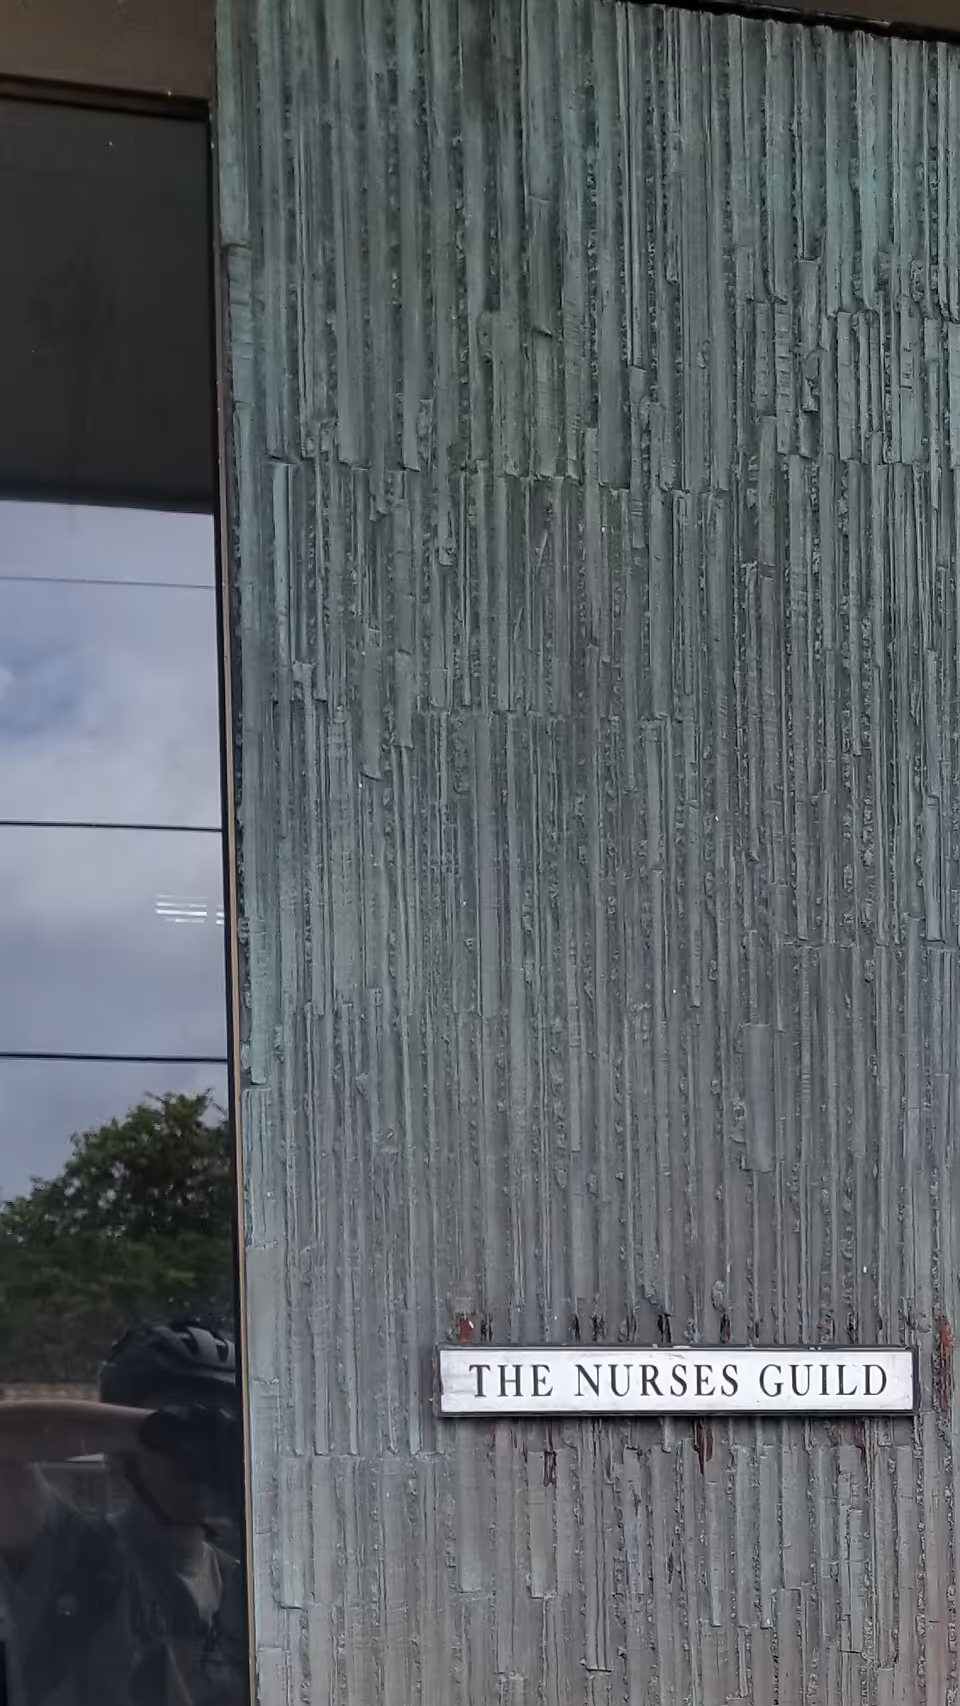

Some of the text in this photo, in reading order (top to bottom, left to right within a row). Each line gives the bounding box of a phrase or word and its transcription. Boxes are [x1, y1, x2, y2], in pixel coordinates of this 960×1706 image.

[468, 1363, 888, 1397] THE NURSES GUILD
